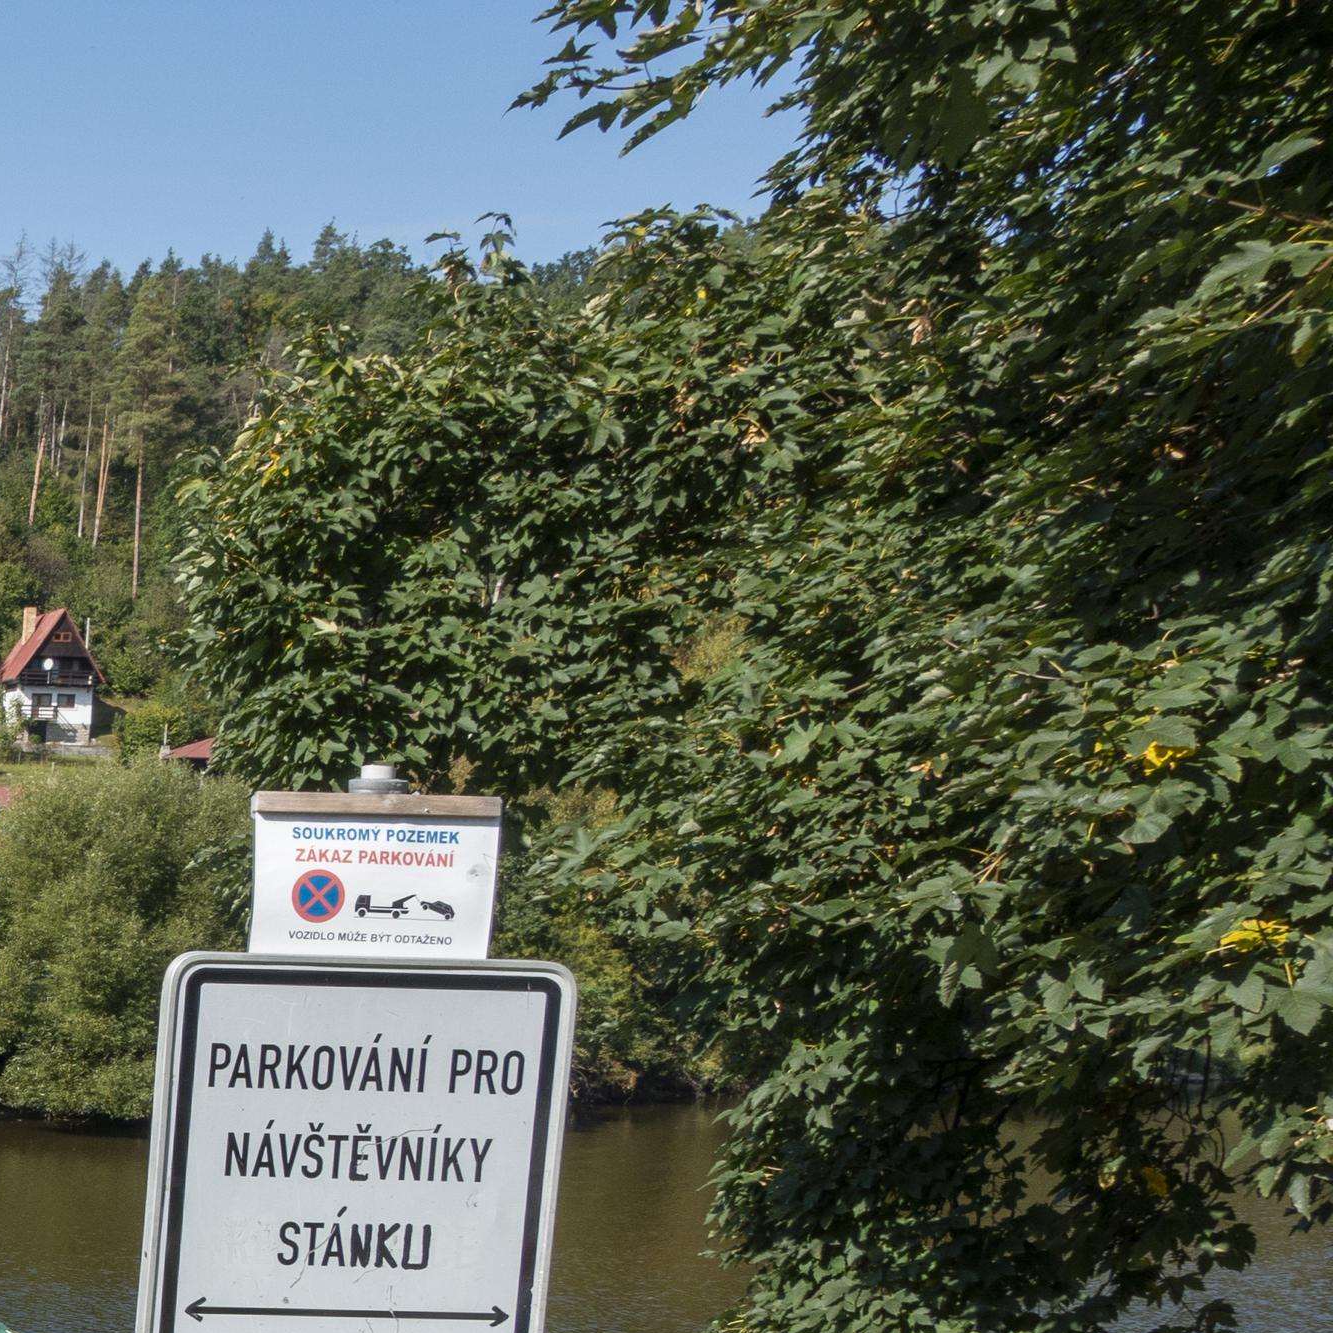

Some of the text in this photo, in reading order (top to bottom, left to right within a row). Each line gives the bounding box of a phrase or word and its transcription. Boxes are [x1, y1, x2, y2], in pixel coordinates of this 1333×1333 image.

[292, 825, 459, 844] SOUKROMÝ POZEMEK
[295, 846, 454, 867] ZÁKAZ PARKOVÁNÍ
[288, 930, 452, 945] VOZIDLO MŮŽE BÝT ODTAŽENO
[208, 1033, 525, 1095] PARKOVÁNÍ PRO
[224, 1119, 493, 1183] NÁVŠTĚVNÍKY
[277, 1205, 432, 1270] STÁNKU
